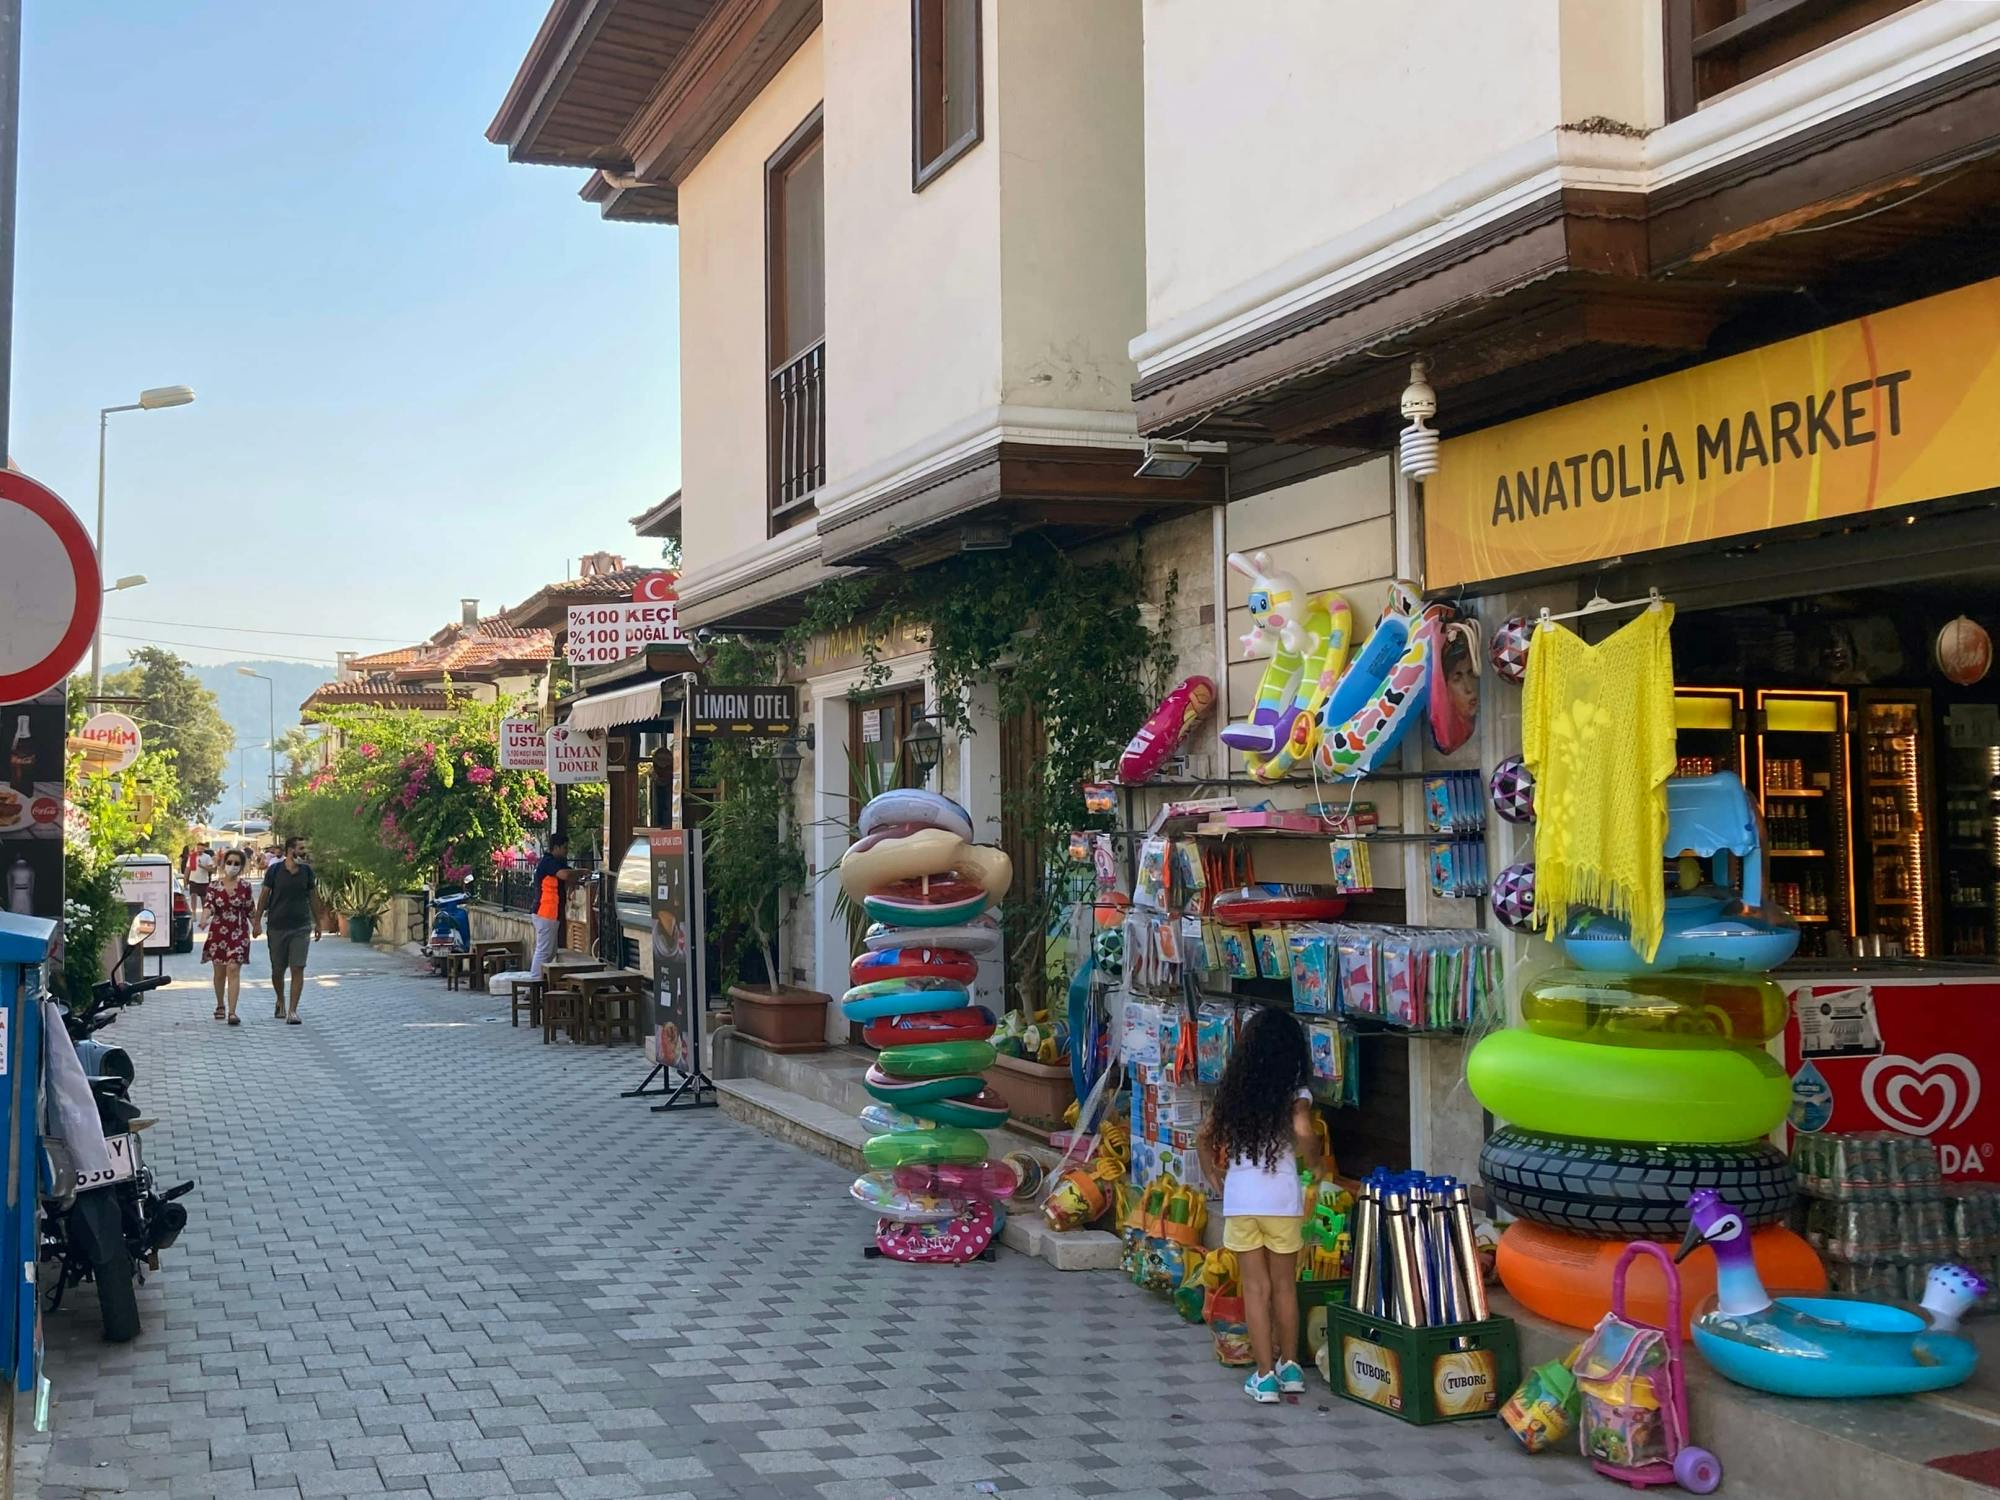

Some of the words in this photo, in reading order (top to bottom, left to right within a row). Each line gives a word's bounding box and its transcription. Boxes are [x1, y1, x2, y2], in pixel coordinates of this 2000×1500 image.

[1492, 424, 1685, 527] ANATOLİA
[1696, 370, 1912, 481] MARKET
[570, 610, 619, 626] %100
[625, 604, 679, 625] KEÇİ
[570, 629, 619, 645] %100
[625, 625, 669, 642] DOĞAL
[570, 647, 619, 662] %100
[695, 689, 748, 719] LİMAN
[754, 695, 791, 719] OTEL
[510, 736, 546, 748] USTA
[555, 743, 602, 758] LİMAN
[1355, 1360, 1391, 1385] TUBORG
[1447, 1374, 1487, 1389] TUBORG
